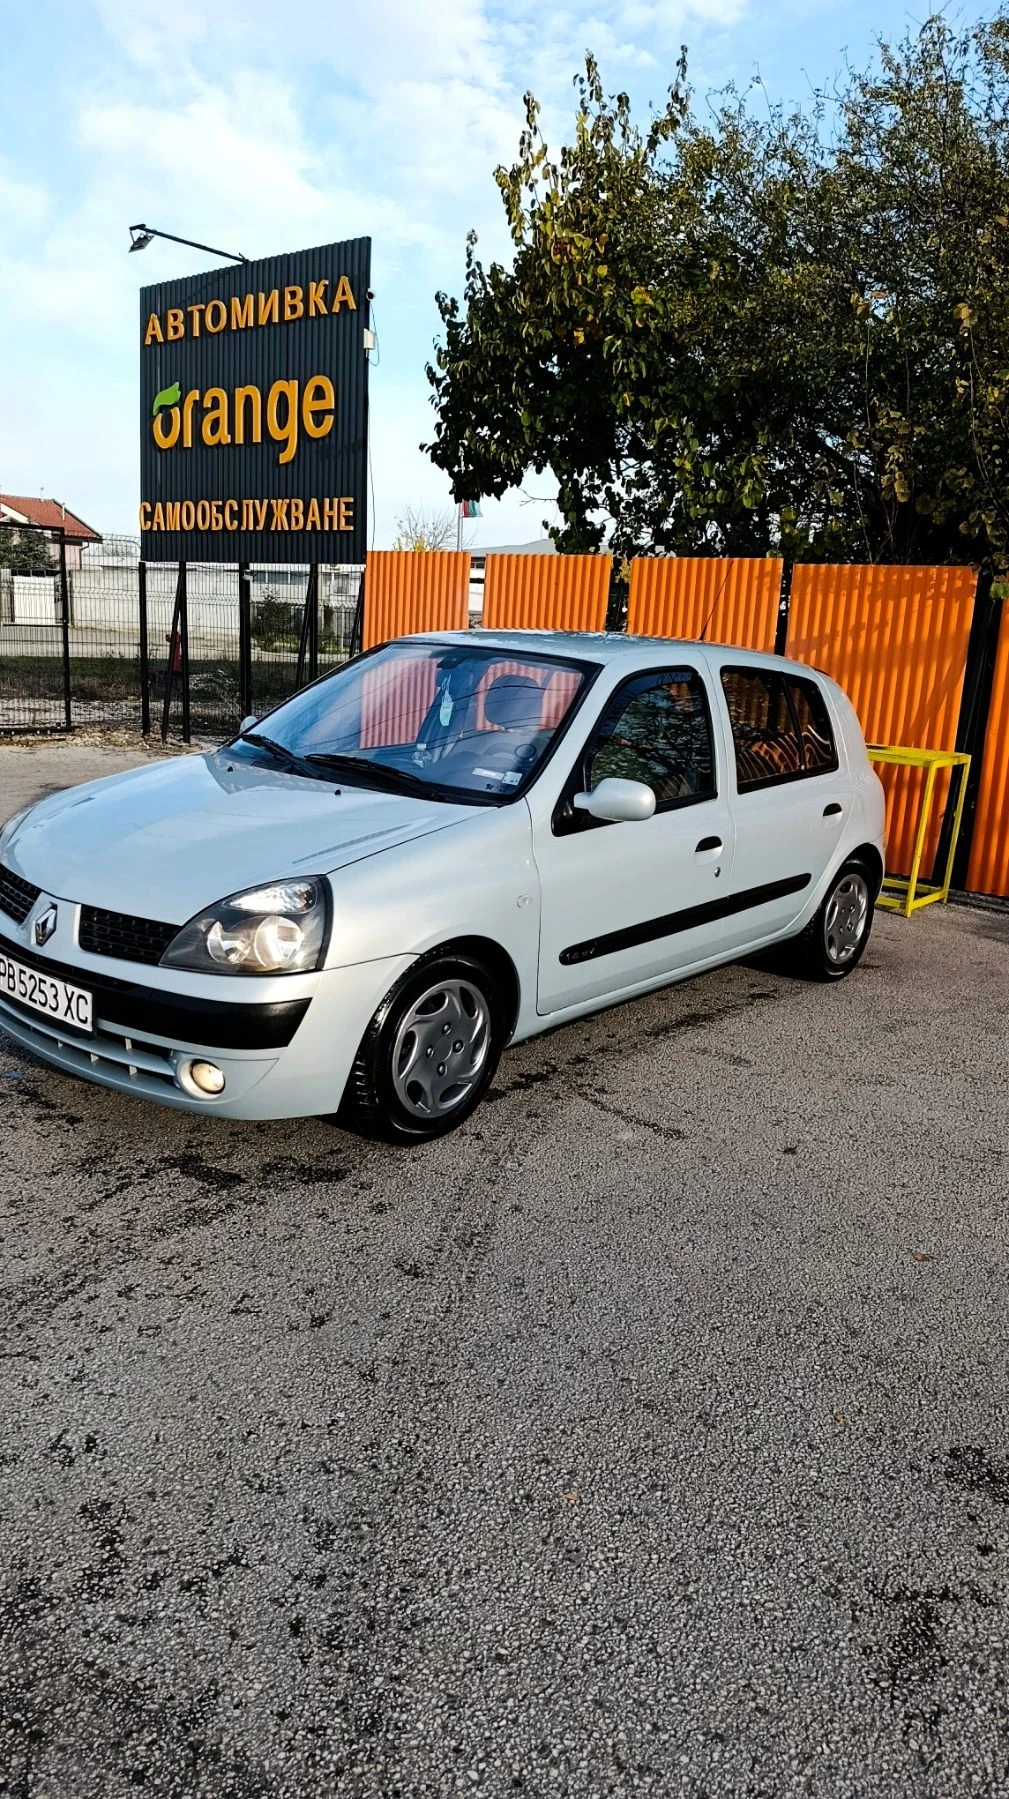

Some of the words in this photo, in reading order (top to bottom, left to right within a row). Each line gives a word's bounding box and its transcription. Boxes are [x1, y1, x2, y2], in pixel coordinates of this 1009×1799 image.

[145, 275, 357, 345] АВТОМИВКА
[153, 375, 335, 464] orange
[140, 498, 354, 531] САМООБСЛУЖВАНЕ
[19, 968, 59, 1012] 5253
[64, 984, 88, 1025] XC
